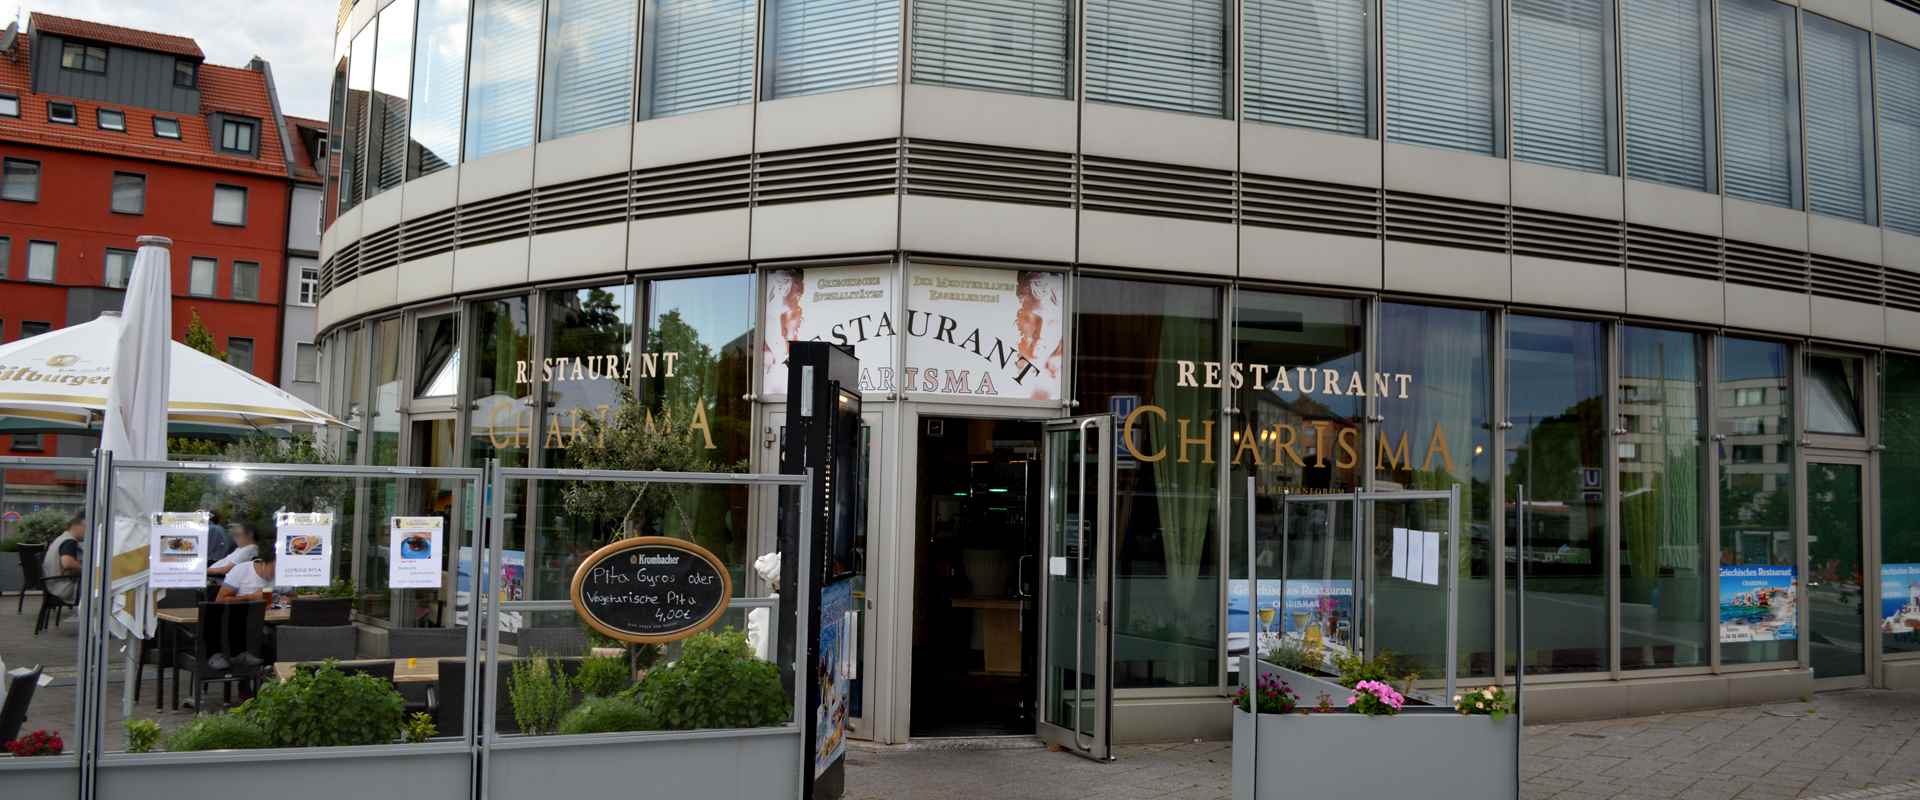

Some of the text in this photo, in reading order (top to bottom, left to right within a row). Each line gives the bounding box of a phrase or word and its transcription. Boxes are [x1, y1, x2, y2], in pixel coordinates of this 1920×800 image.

[782, 309, 1041, 386] STAURANT
[858, 366, 999, 395] ARISMA
[1176, 360, 1413, 399] RESTAURANT
[488, 397, 717, 449] CHARIMA
[1123, 404, 1455, 472] CHARISMA
[638, 553, 680, 565] Krombacher
[593, 565, 715, 587] Pita Gyros oder
[666, 590, 697, 605] Pita
[1302, 583, 1353, 596] Restauran
[655, 608, 693, 623] 4,00€
